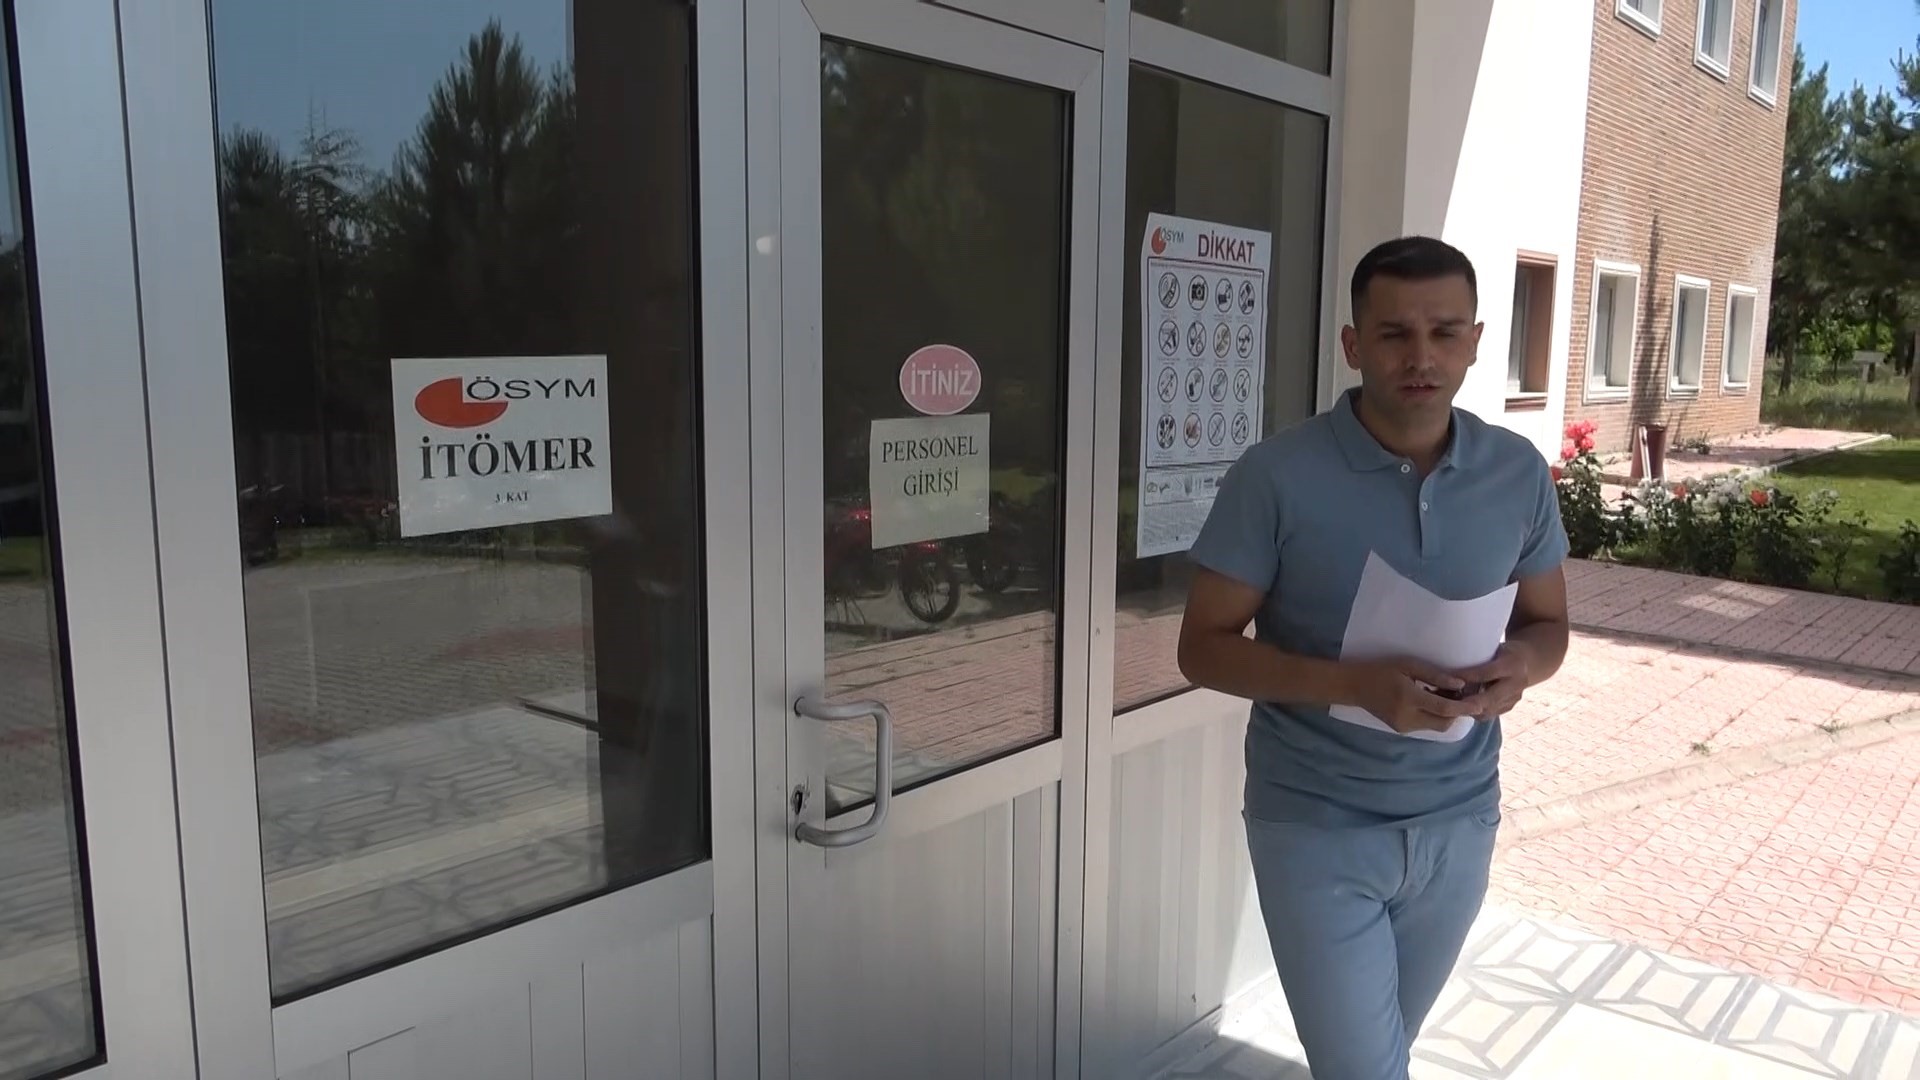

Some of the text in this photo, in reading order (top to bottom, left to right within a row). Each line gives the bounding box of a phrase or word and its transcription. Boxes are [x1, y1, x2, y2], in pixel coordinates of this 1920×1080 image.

[1161, 227, 1184, 243] ÖSYM
[1198, 230, 1255, 264] DİKKAT
[466, 376, 596, 401] ÖSYM
[910, 362, 973, 396] İTİNİZ
[419, 433, 595, 480] İTÖMER
[882, 435, 979, 463] PERSONEL
[506, 490, 529, 502] KAT
[903, 466, 959, 497] GİRİŞİ
